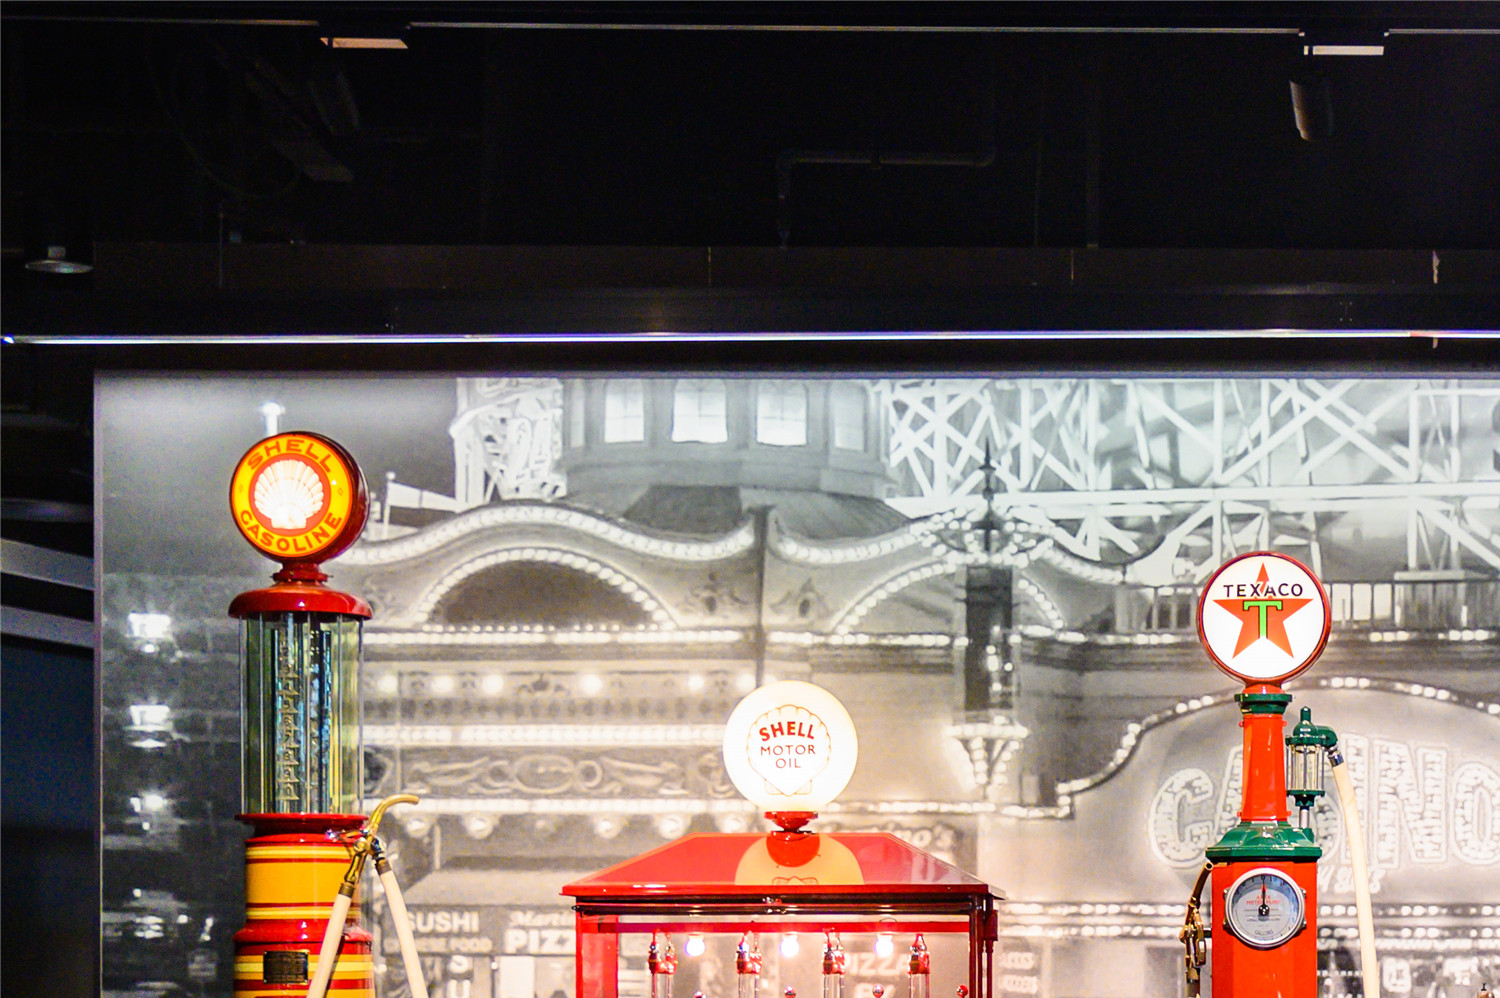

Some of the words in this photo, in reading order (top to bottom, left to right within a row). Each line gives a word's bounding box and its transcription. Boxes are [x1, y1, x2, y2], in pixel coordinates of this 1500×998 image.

[247, 439, 331, 473] SHELL
[240, 510, 342, 552] GASOLINE
[1223, 583, 1303, 598] TEXACO
[759, 721, 815, 742] SHELL
[760, 744, 816, 756] MOTOR
[775, 758, 802, 769] OIL
[504, 928, 576, 954] PIZZ
